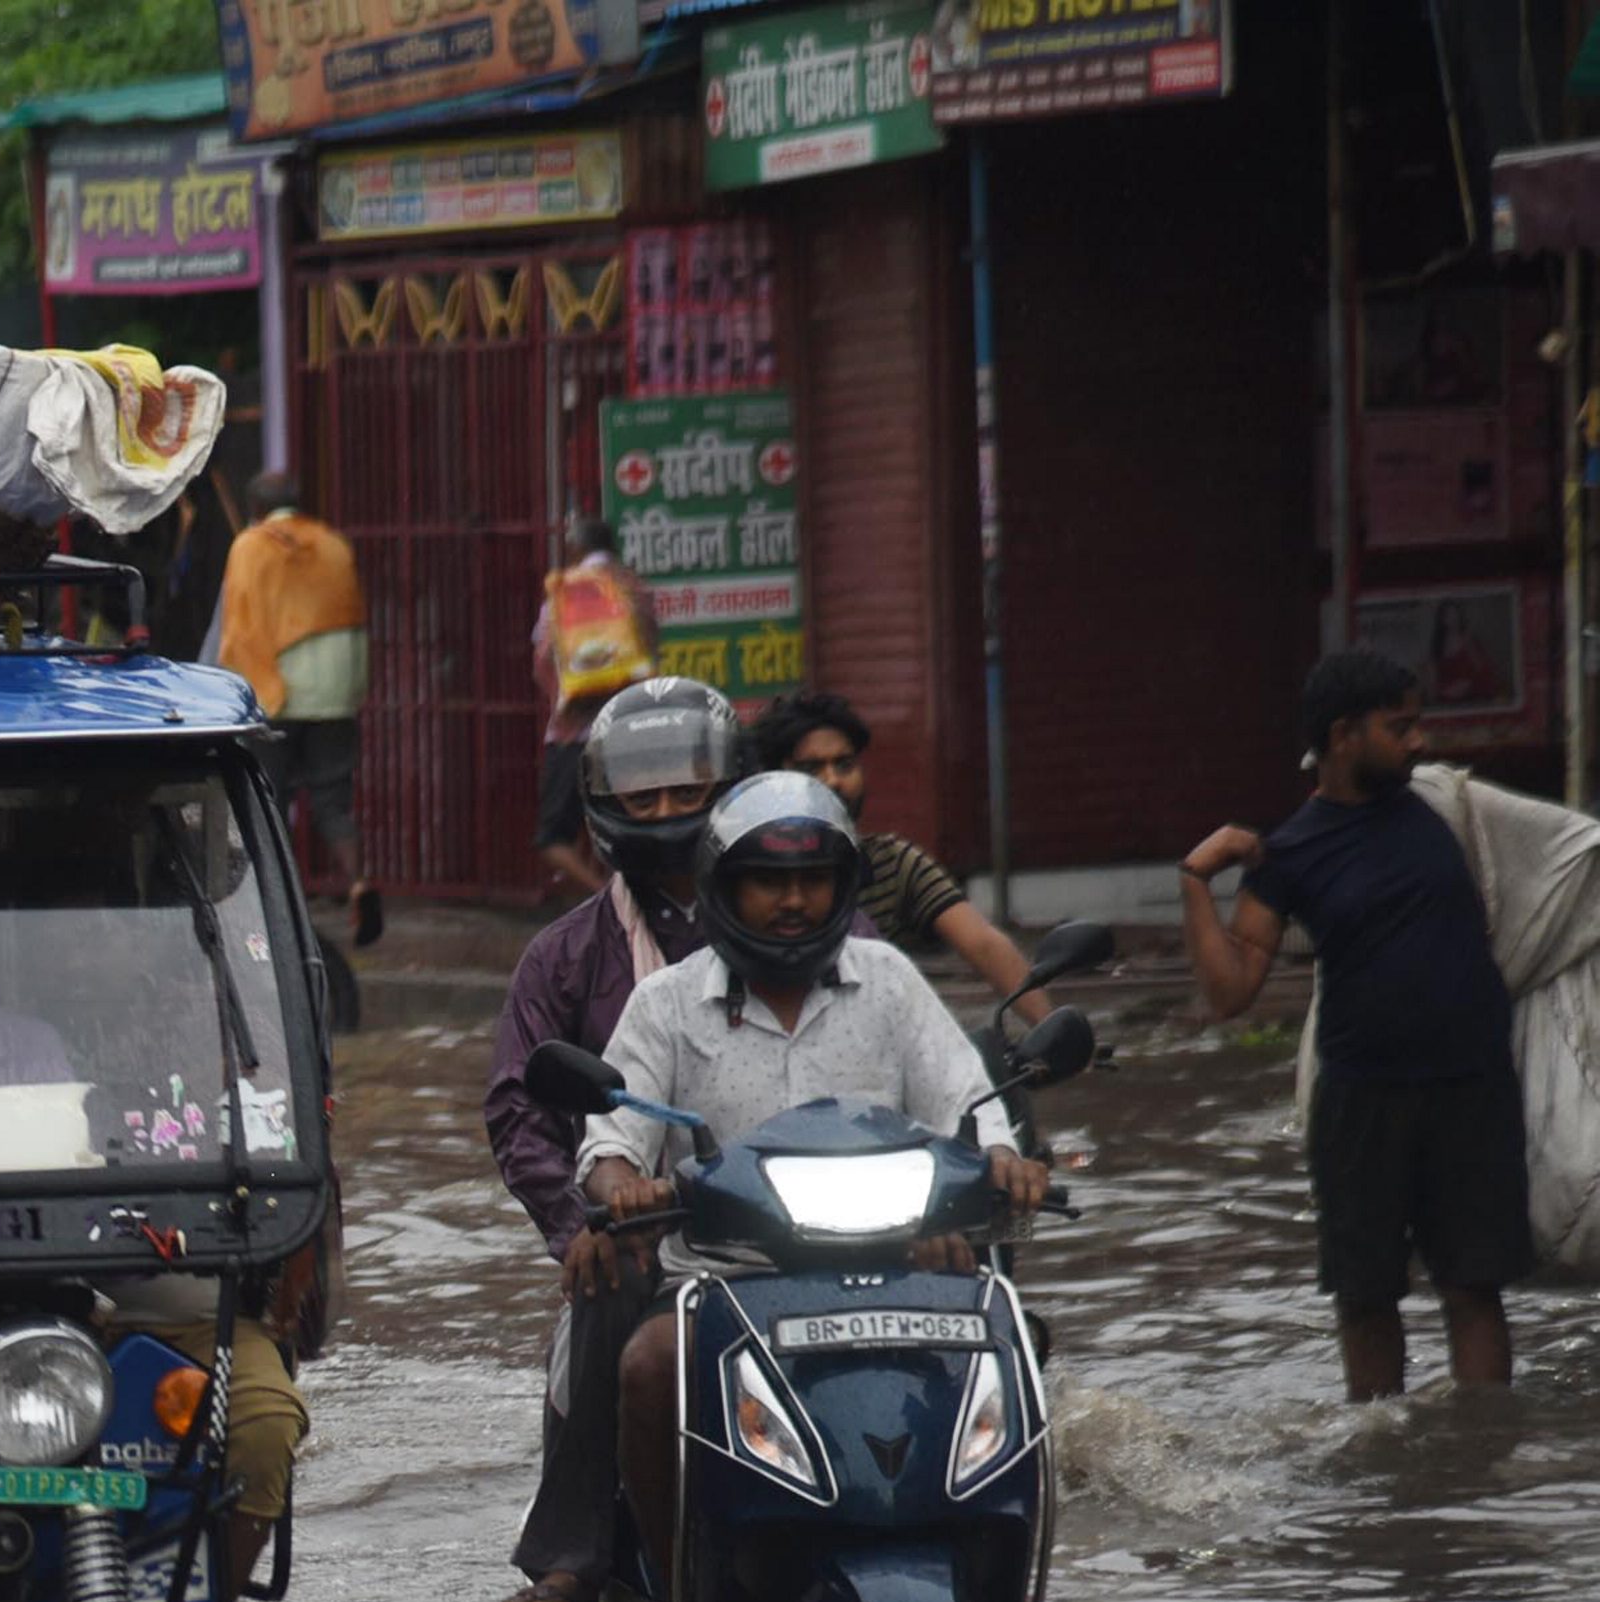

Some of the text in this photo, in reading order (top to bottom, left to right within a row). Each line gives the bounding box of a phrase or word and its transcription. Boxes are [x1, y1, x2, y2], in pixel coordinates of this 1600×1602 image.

[726, 43, 778, 140] संदीप
[81, 162, 255, 245] मगध होटल
[657, 433, 757, 499] संदीप
[619, 505, 730, 575] मेडिकल
